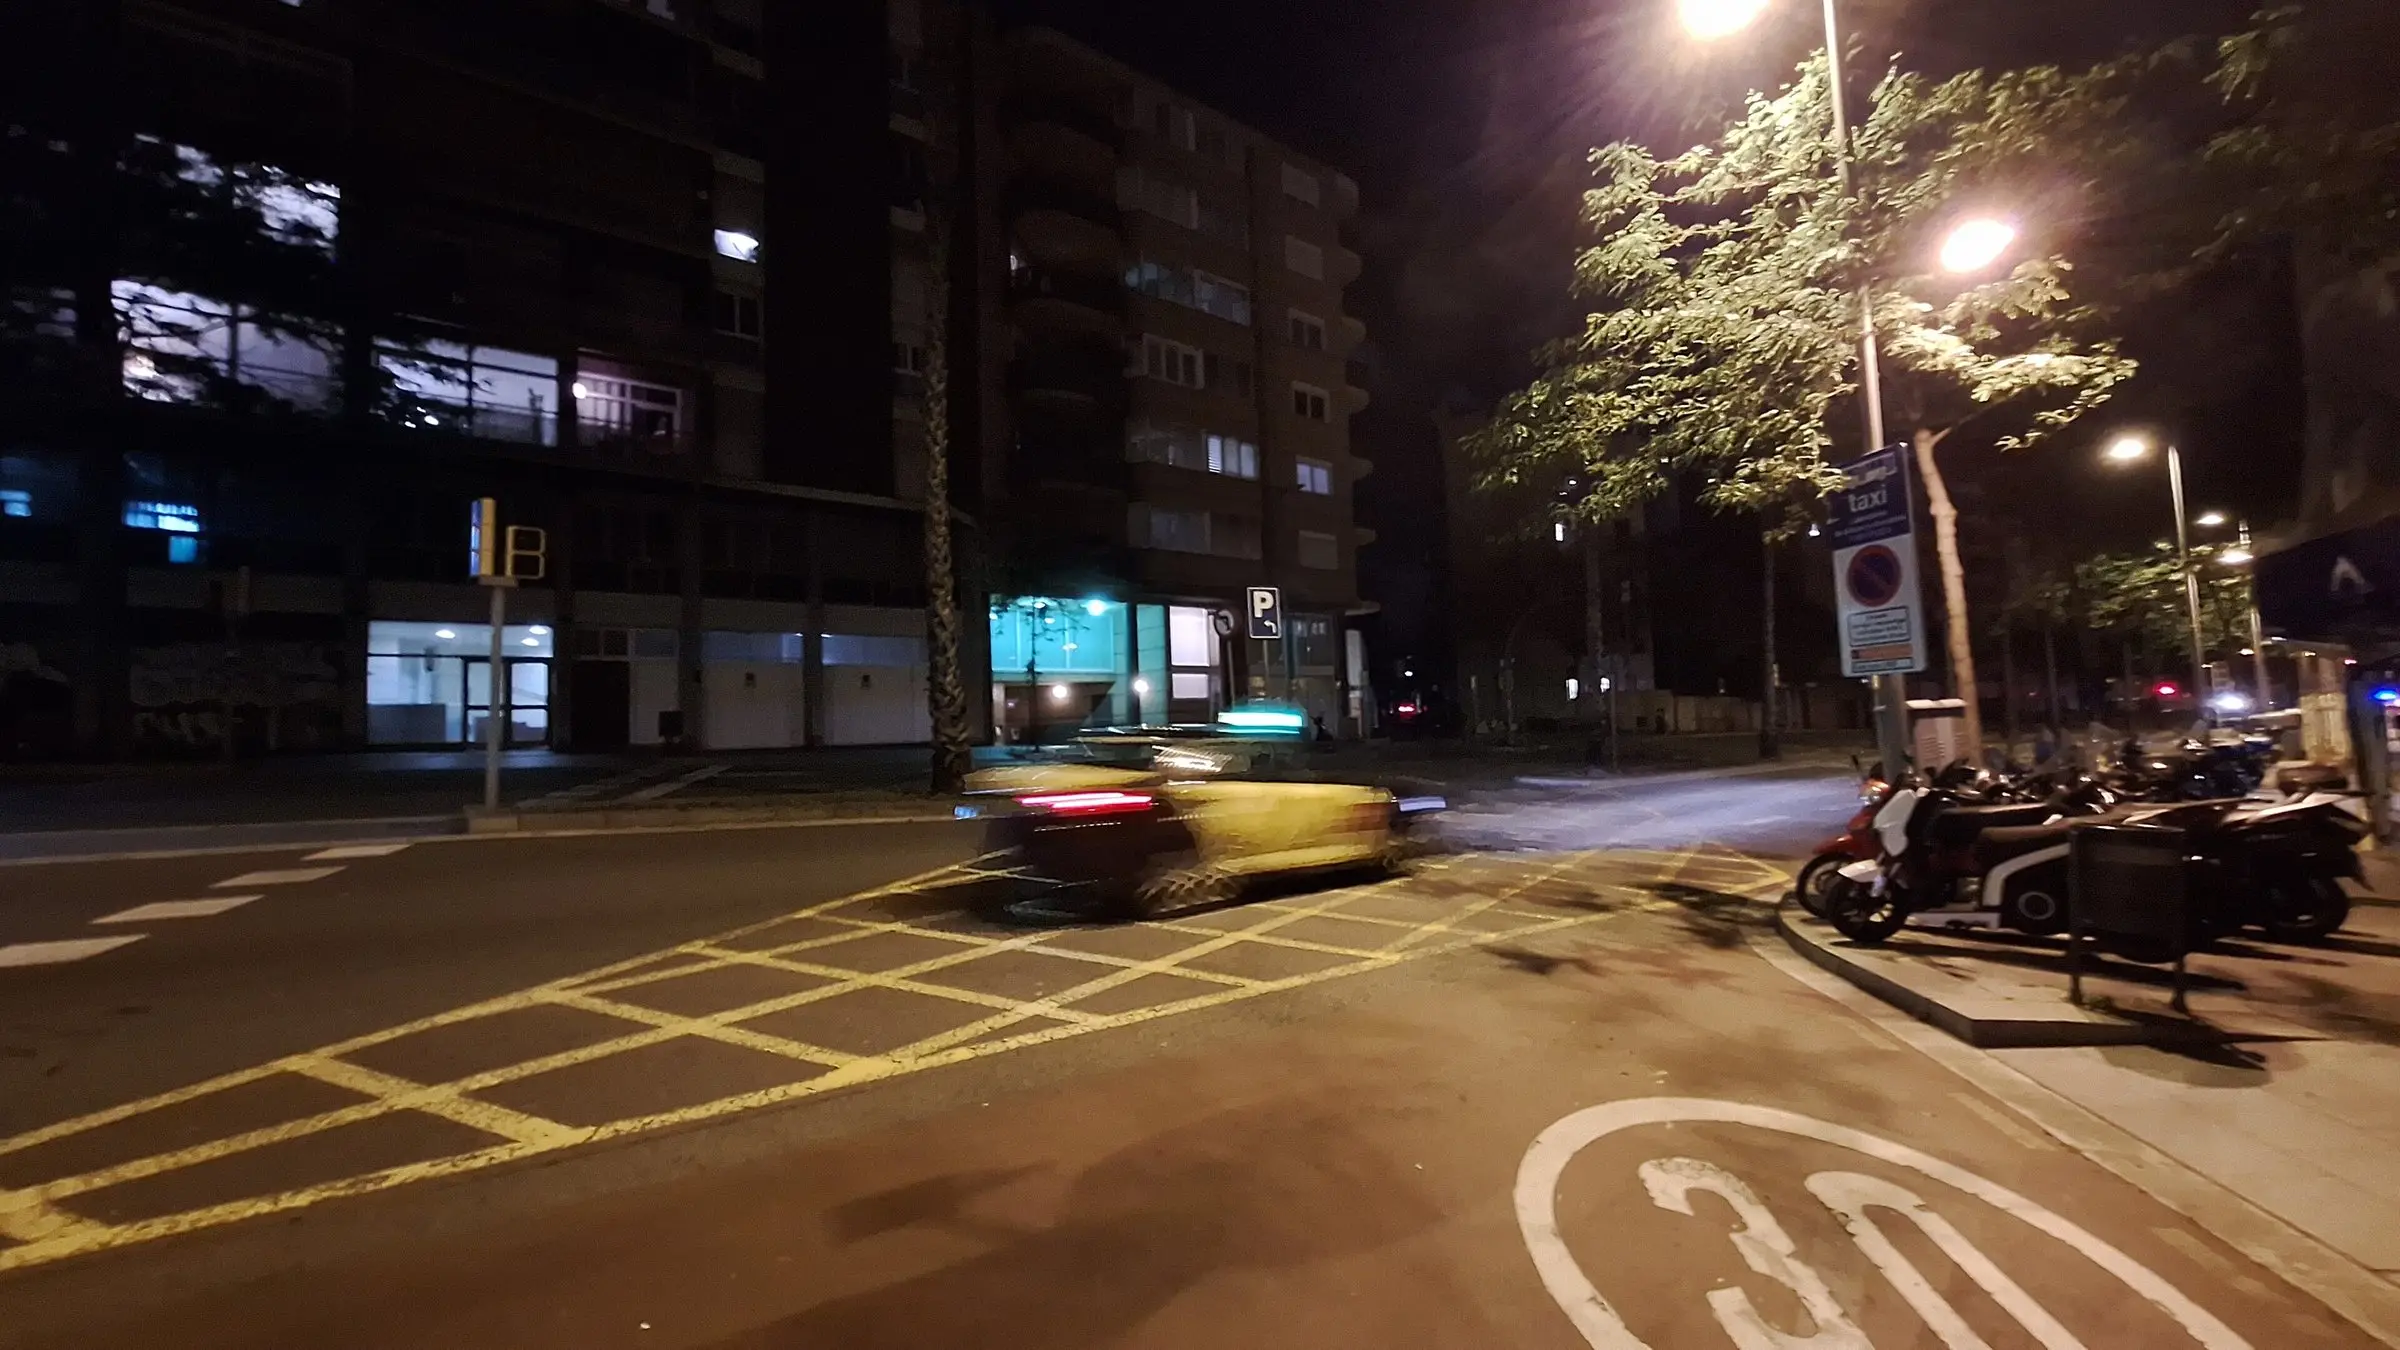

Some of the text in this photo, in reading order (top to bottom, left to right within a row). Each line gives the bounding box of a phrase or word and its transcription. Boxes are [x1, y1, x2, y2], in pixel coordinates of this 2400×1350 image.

[1848, 484, 1888, 512] taxi
[1253, 591, 1274, 617] P
[1638, 1156, 2089, 1350] 30
